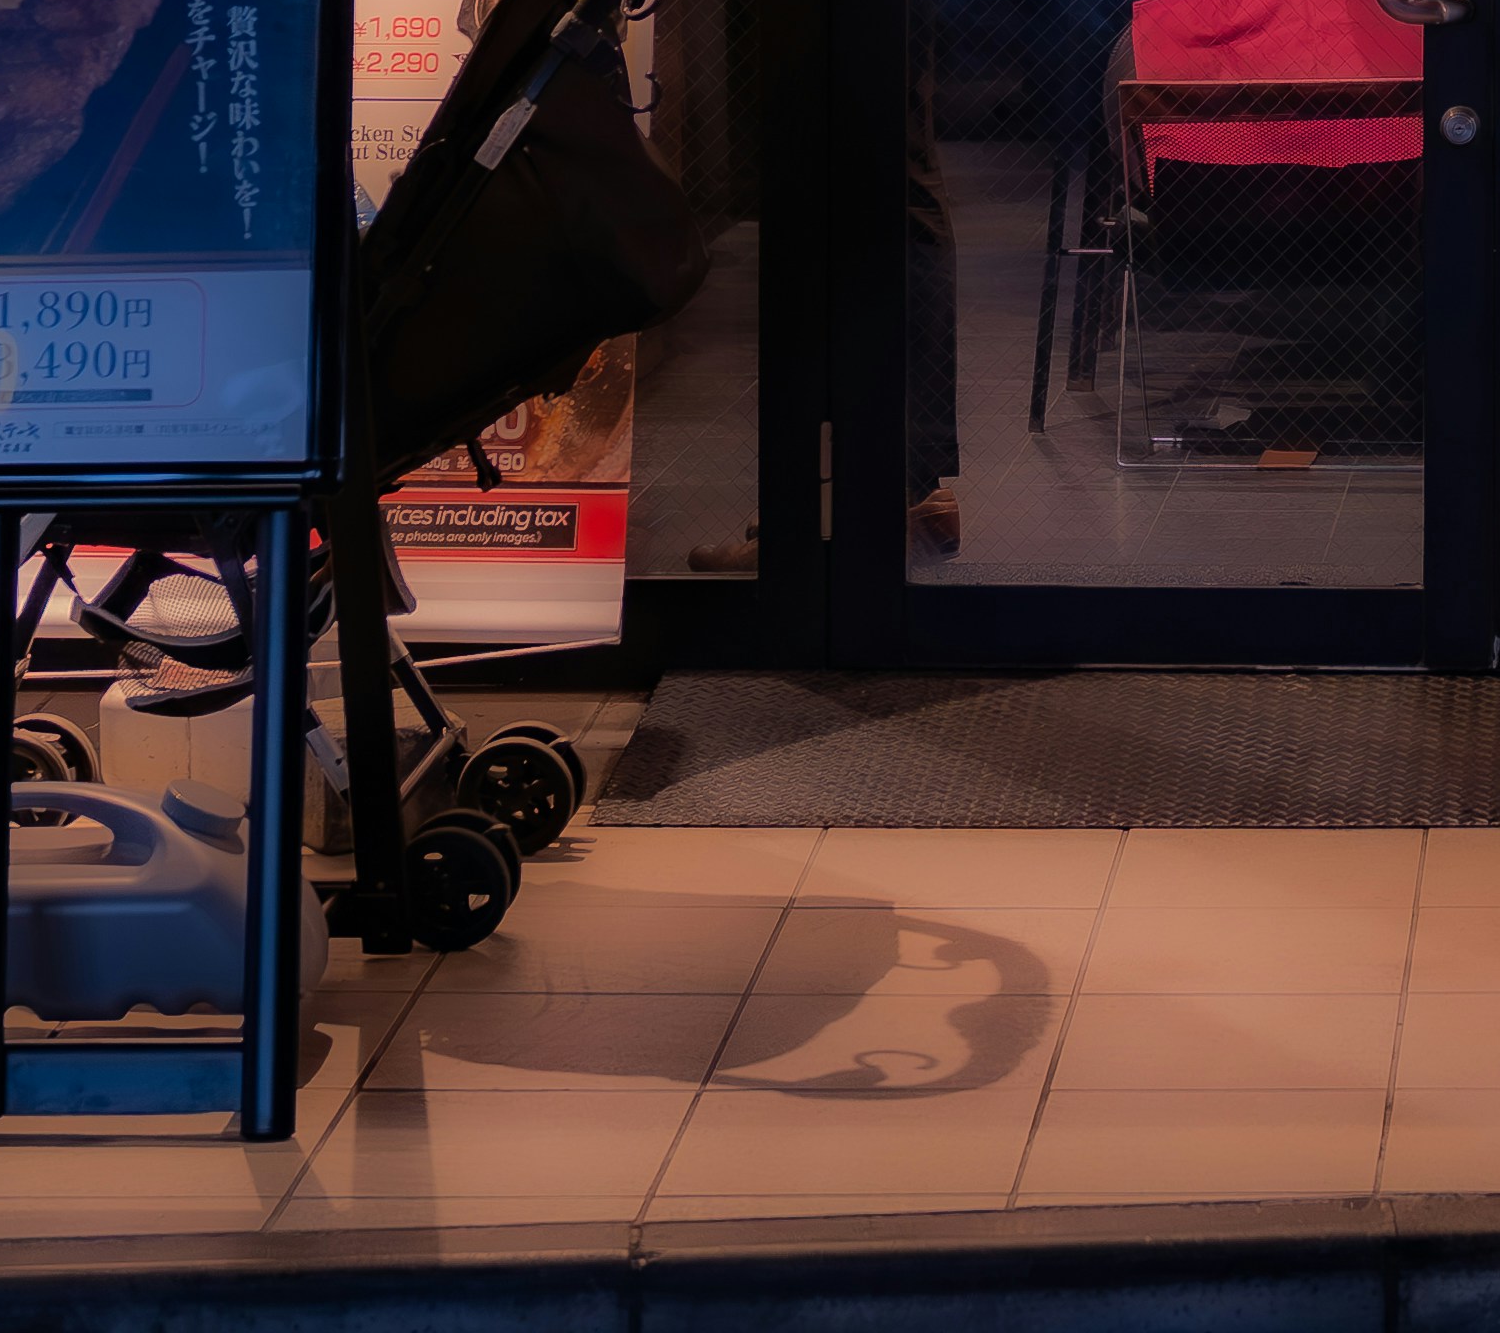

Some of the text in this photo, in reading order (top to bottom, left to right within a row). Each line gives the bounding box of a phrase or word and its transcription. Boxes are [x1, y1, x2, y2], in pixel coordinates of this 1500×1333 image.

[354, 17, 442, 40] ¥1,690
[352, 52, 440, 75] ¥2,290
[435, 505, 571, 531] including tax
